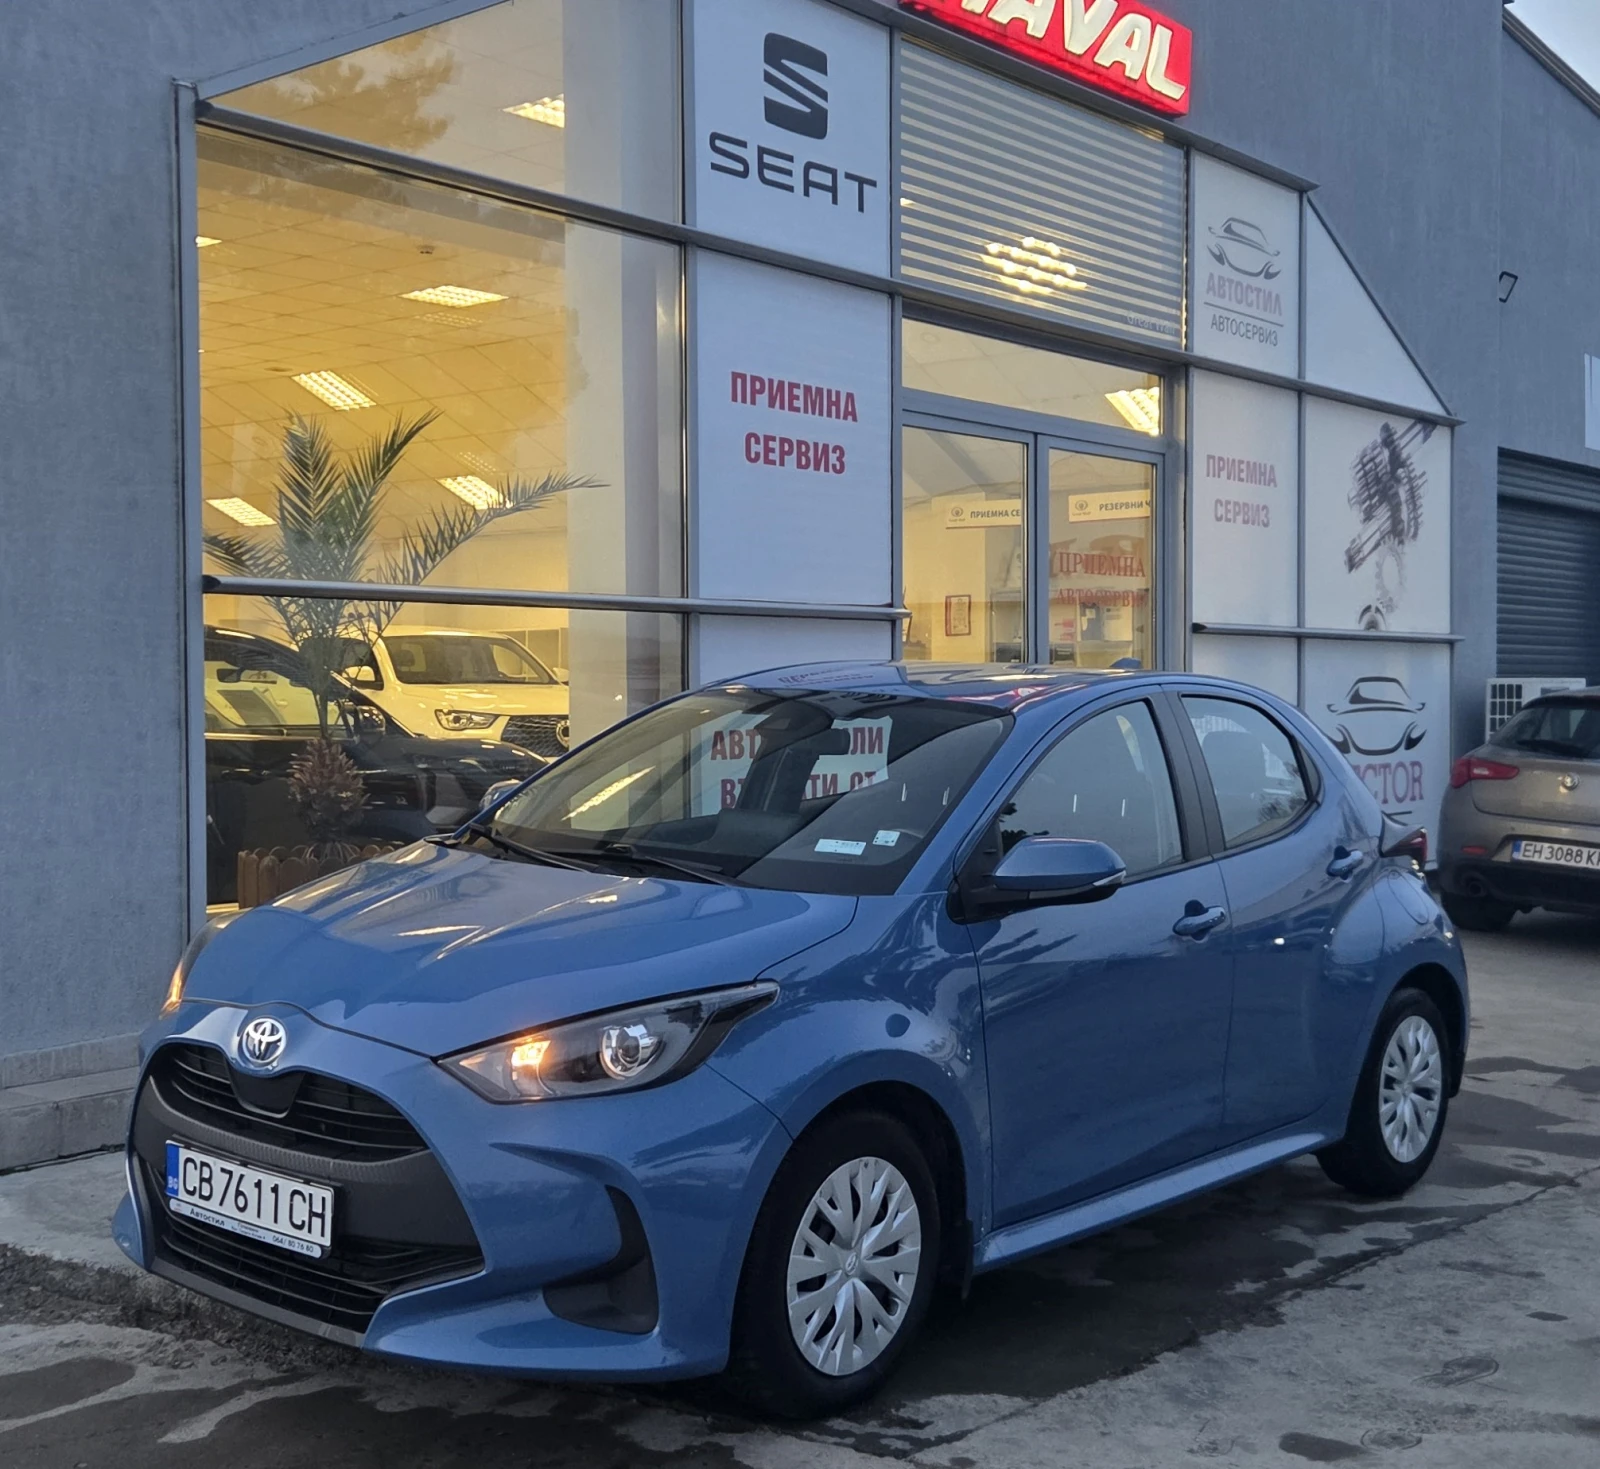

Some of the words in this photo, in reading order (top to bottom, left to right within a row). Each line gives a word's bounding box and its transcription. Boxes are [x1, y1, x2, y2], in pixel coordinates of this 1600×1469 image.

[709, 131, 878, 213] SEAT
[1206, 272, 1282, 316] АВТОСТИЛ
[1210, 313, 1278, 347] АВТОСЕРВИЗ
[731, 371, 858, 422] ПРИЕМНА
[745, 432, 845, 474] СЕРВИЗ
[1206, 454, 1278, 488] ПРИЕМНА
[970, 510, 1009, 519] ПРИЕМНА
[1099, 500, 1144, 511] РЕЗЕРВНИ
[1214, 498, 1270, 528] СЕРВИЗ
[1059, 552, 1146, 577] ПРИЕМНА
[183, 1157, 326, 1237] CB7611CH
[190, 1208, 225, 1227] Автостил
